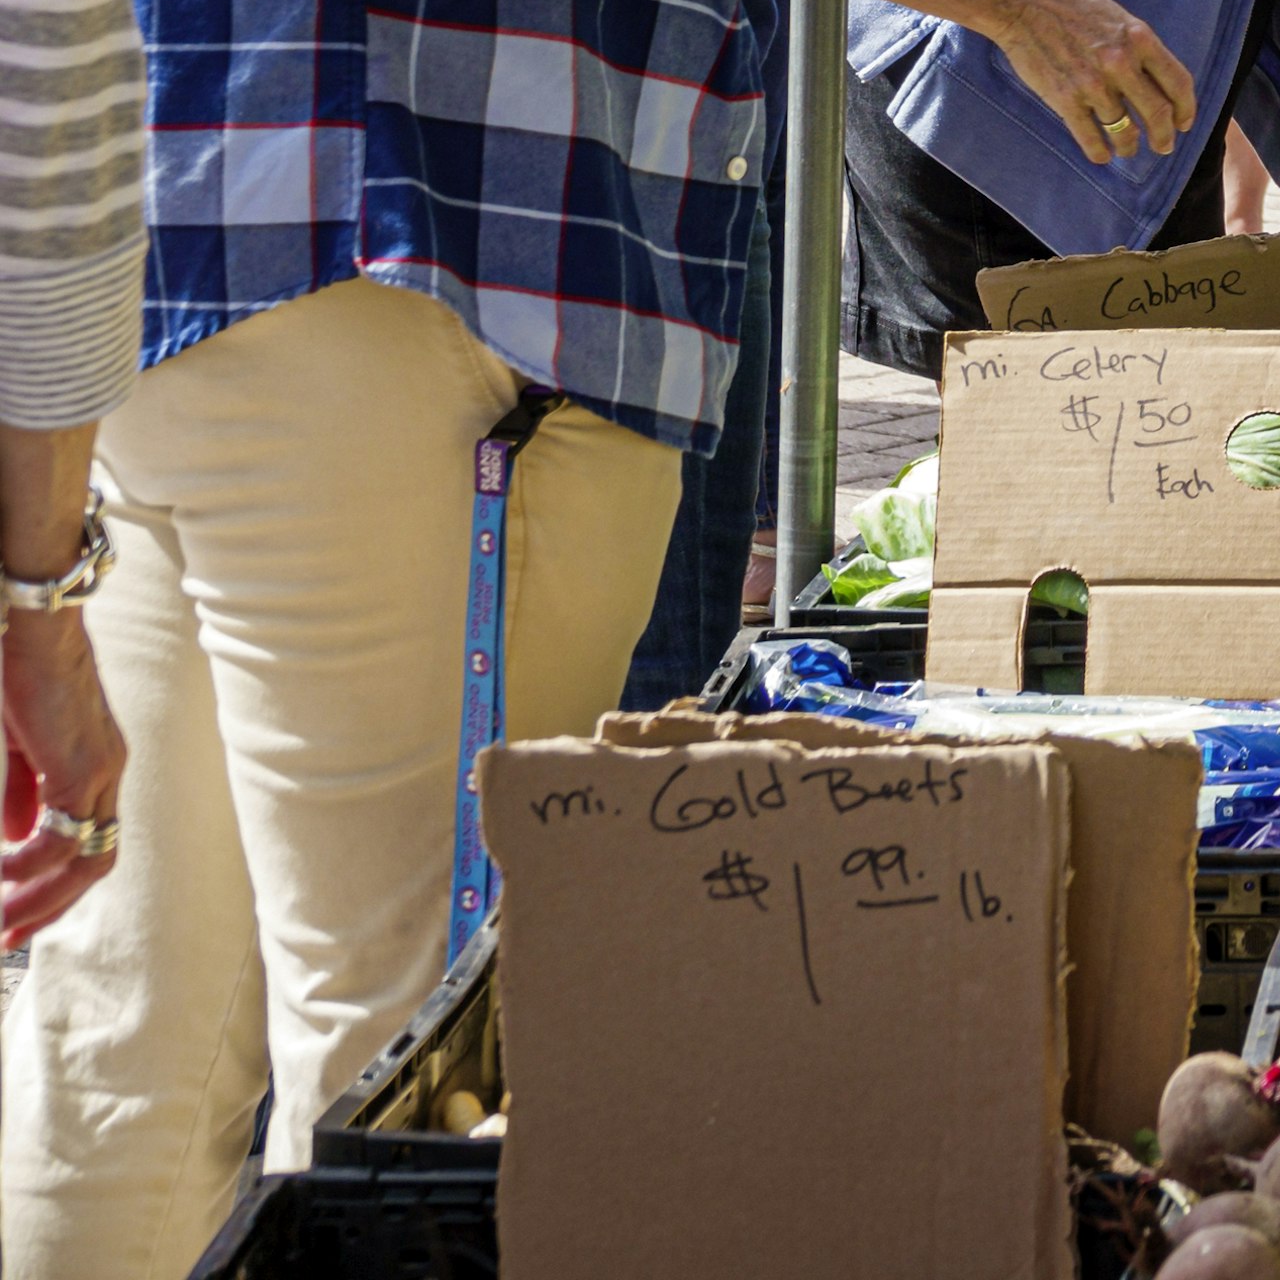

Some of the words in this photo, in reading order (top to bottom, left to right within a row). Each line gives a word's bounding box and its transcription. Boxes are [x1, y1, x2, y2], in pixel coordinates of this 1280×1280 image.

[1100, 269, 1247, 320] Cabbage
[1039, 345, 1168, 386] Celery
[490, 448, 503, 490] PRIDE
[1155, 462, 1215, 501] Each
[469, 562, 487, 640] ORLANDO
[464, 683, 481, 759] ORLANDO
[650, 762, 788, 833] Gold
[800, 758, 970, 815] Beets
[459, 802, 474, 877] ORLANDO
